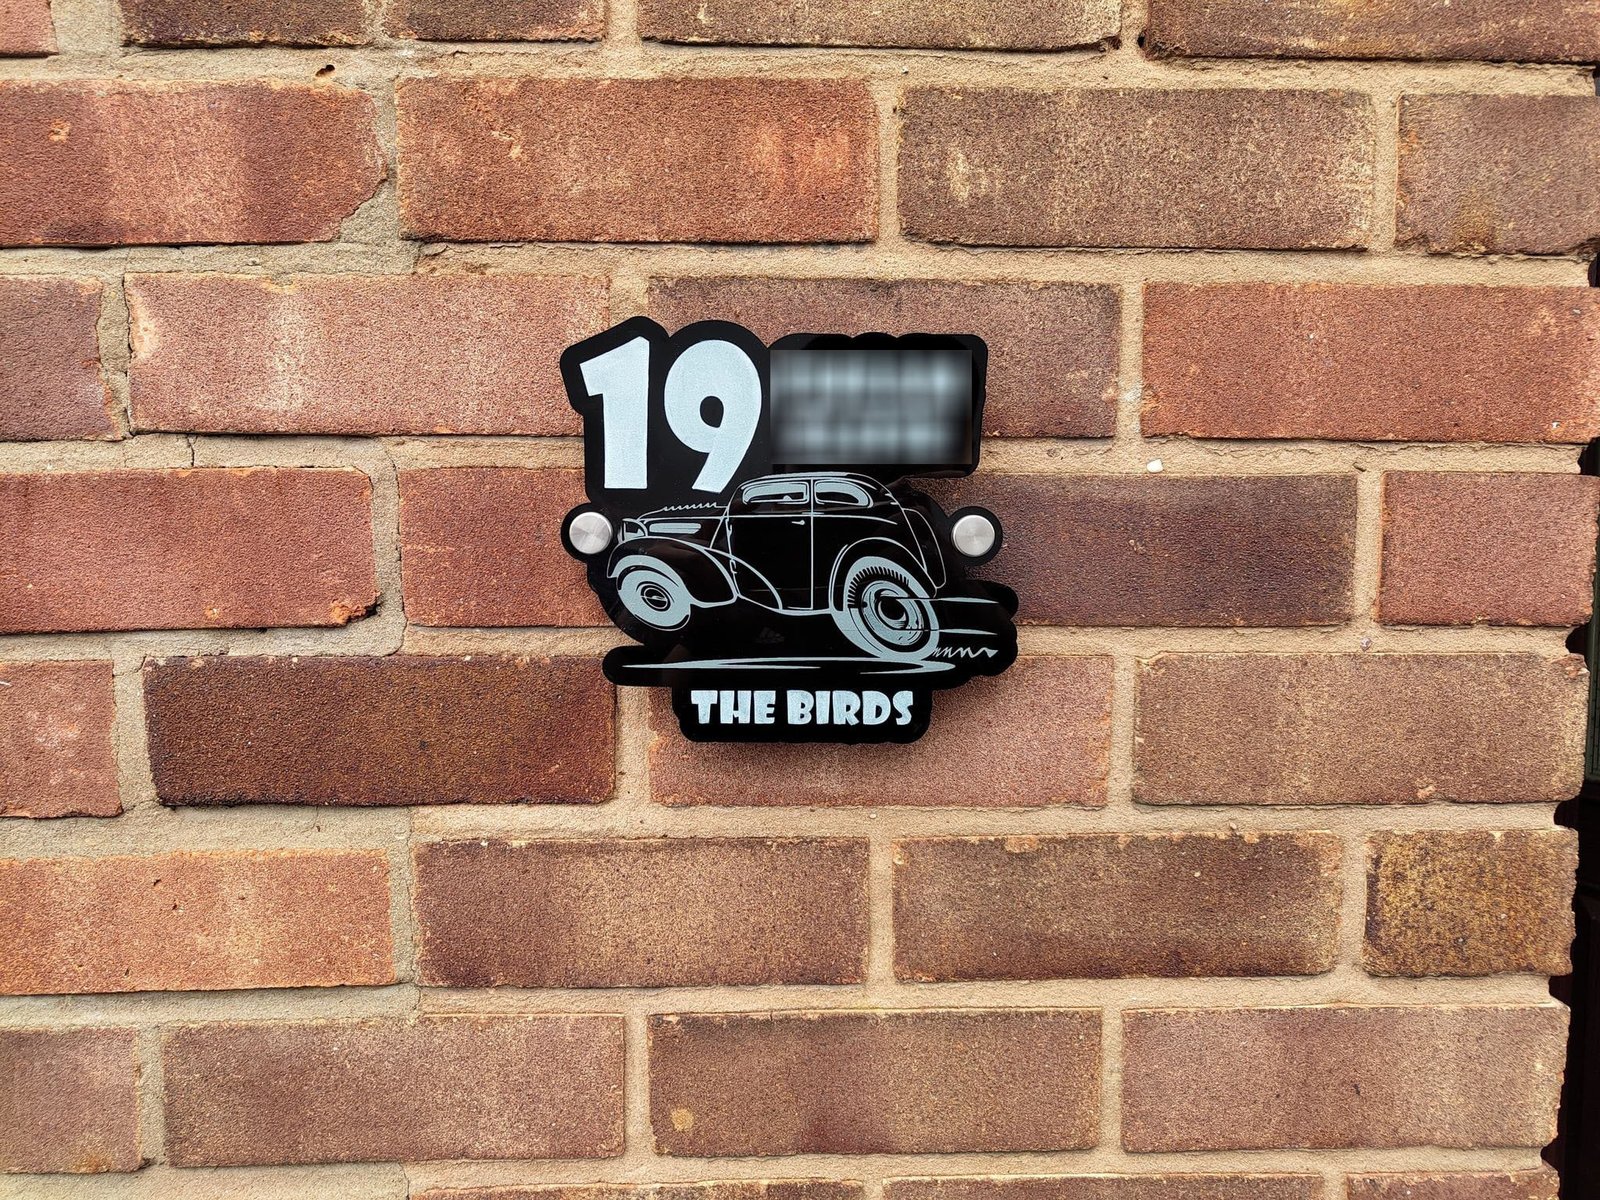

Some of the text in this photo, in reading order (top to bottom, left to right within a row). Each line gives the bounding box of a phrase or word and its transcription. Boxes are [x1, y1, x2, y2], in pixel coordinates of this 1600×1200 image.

[579, 336, 763, 494] 19
[690, 689, 914, 726] THE BIRDS
